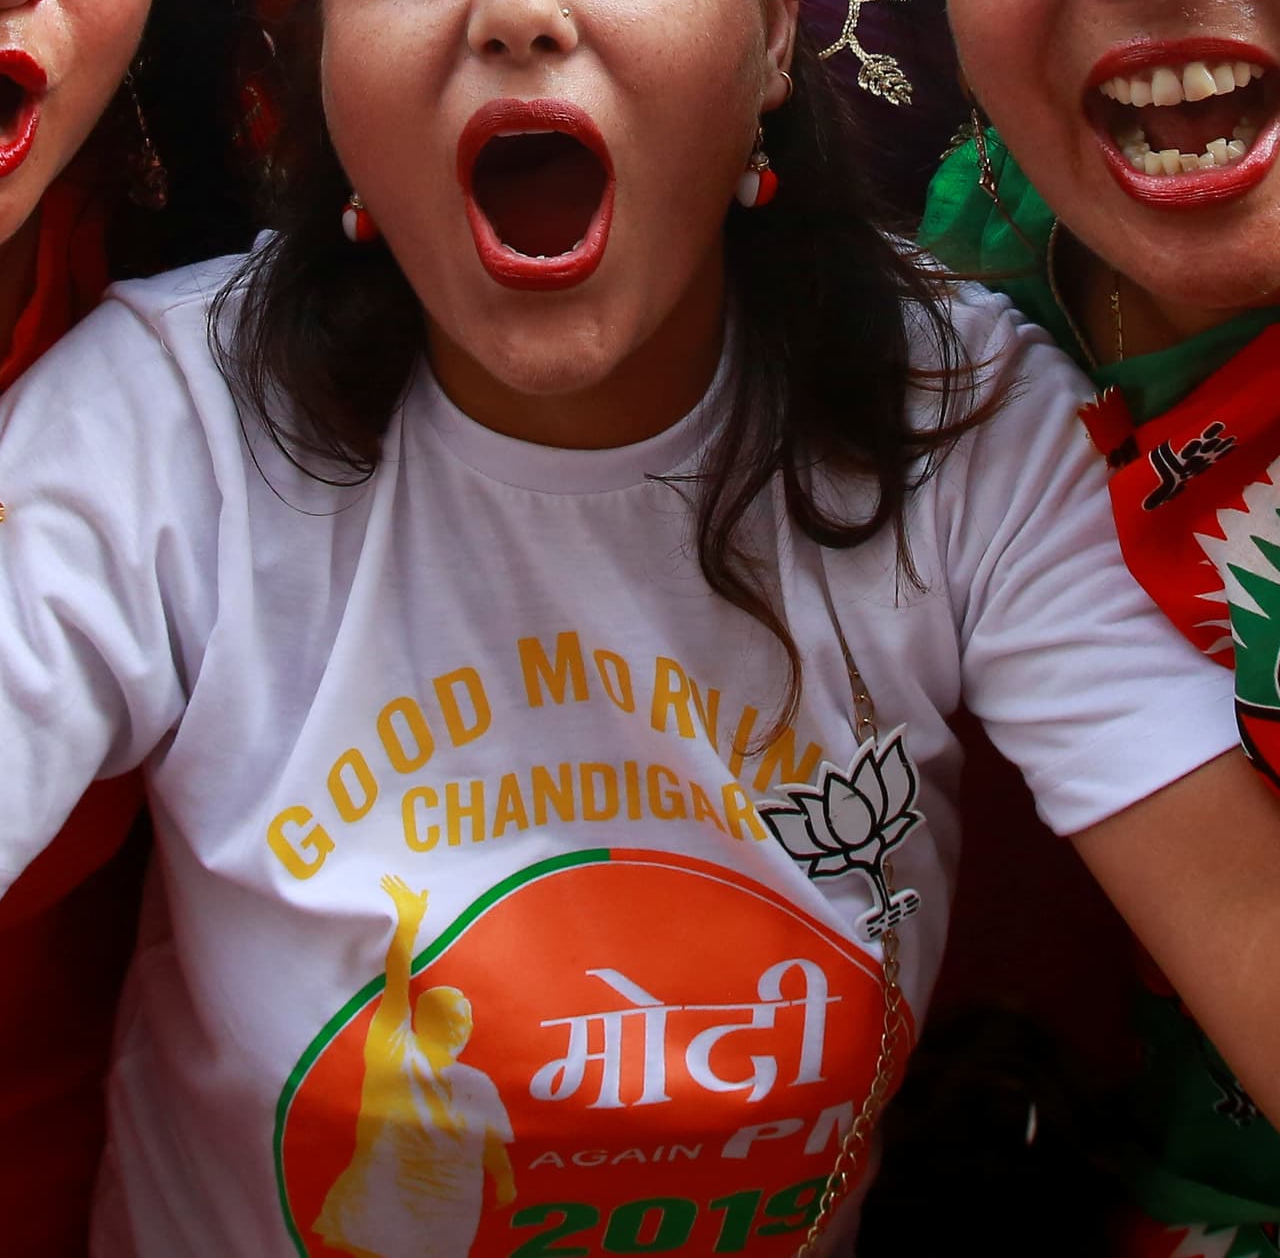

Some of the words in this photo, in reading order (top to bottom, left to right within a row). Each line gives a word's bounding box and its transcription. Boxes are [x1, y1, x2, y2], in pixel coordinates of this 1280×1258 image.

[267, 666, 492, 880] GOOD
[517, 630, 824, 793] MORNIN
[401, 760, 768, 853] CHANDIGAR
[529, 958, 843, 1109] मोदी
[528, 1143, 704, 1170] AGAIN
[505, 1174, 841, 1258] 2019
